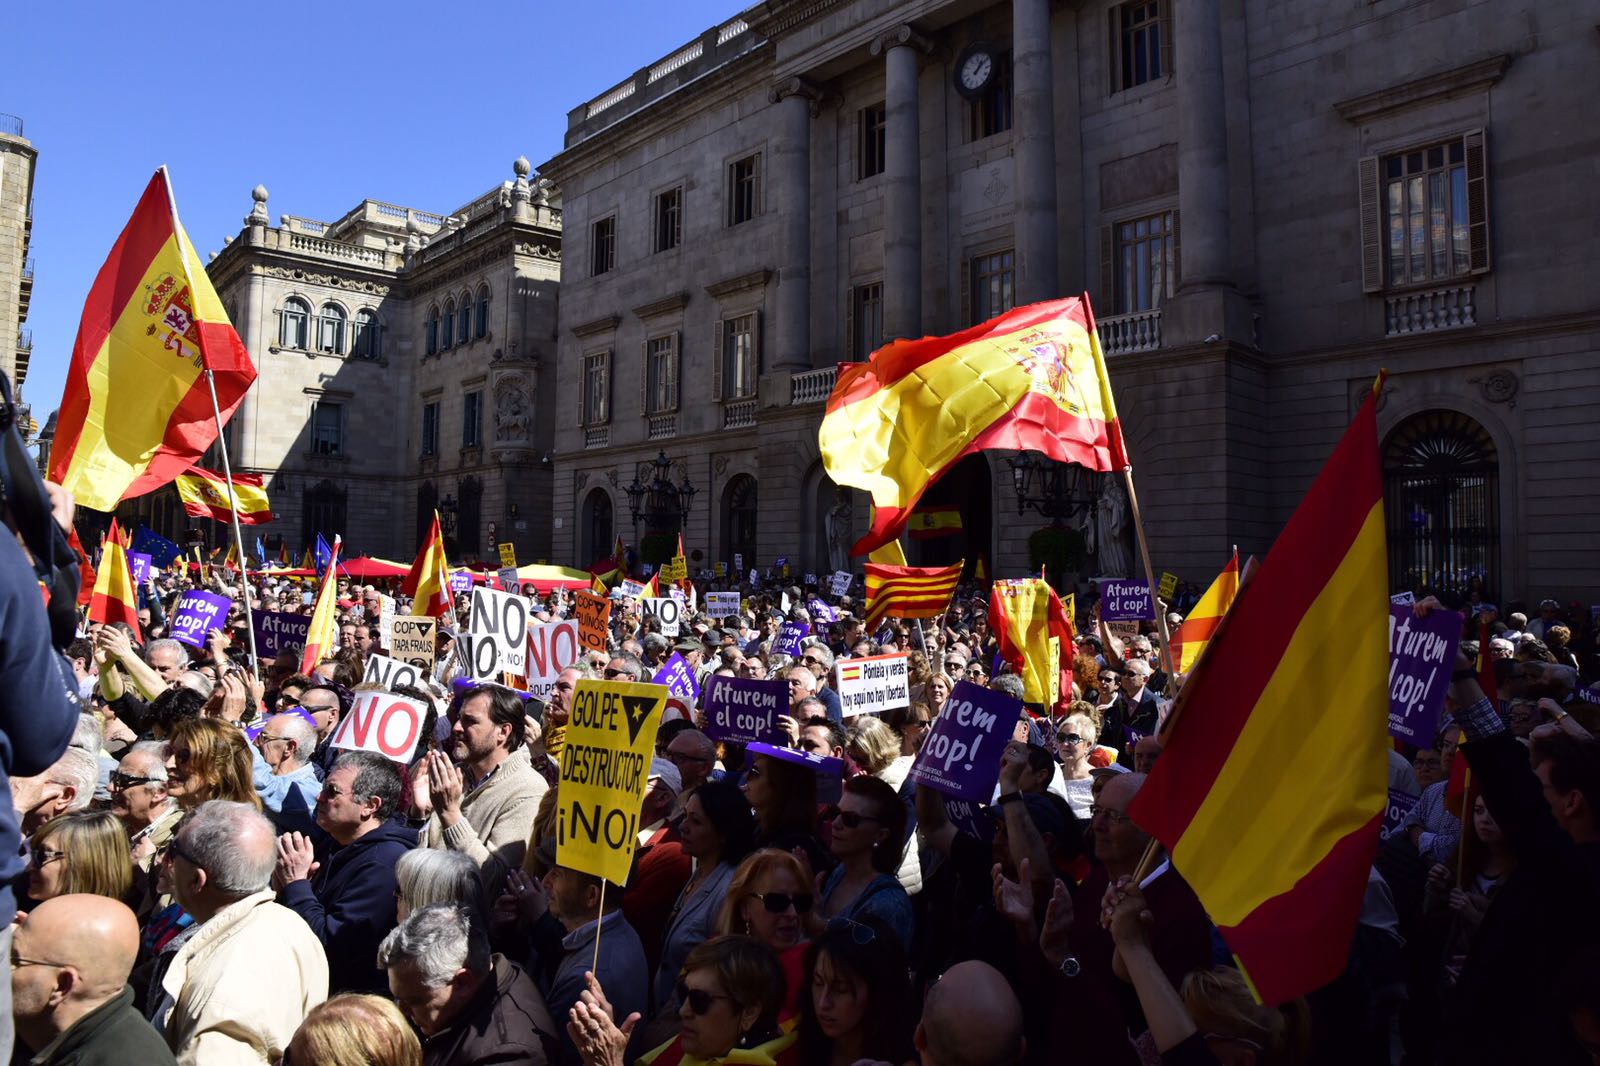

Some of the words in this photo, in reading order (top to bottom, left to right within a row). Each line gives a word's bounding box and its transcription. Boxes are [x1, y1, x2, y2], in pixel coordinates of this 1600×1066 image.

[577, 595, 593, 609] COP
[1107, 583, 1150, 598] Aturem
[643, 599, 678, 625] NO
[1109, 599, 1120, 611] el
[1123, 596, 1148, 613] cop!
[174, 614, 211, 635] cop!
[394, 621, 415, 634] COP
[471, 590, 526, 649] NO
[265, 634, 278, 650] el
[394, 639, 409, 652] TAPA
[525, 623, 577, 679] NO
[578, 631, 605, 650] NO!
[507, 652, 524, 666] NO!
[863, 662, 885, 680] Póntela
[885, 665, 889, 681] y
[365, 656, 416, 690] NO
[712, 681, 777, 708] Aturem
[841, 691, 852, 711] hoy
[853, 688, 866, 709] aquí
[866, 691, 875, 703] no
[875, 686, 885, 706] hay
[1391, 667, 1437, 717] cop!
[572, 689, 620, 732] GOLPE
[715, 705, 731, 727] el
[736, 709, 773, 738] cop!
[335, 696, 419, 757] NO
[926, 732, 984, 772] cop!
[562, 743, 644, 801] DESTRUCTOR,
[558, 800, 636, 854] ¡NO!
